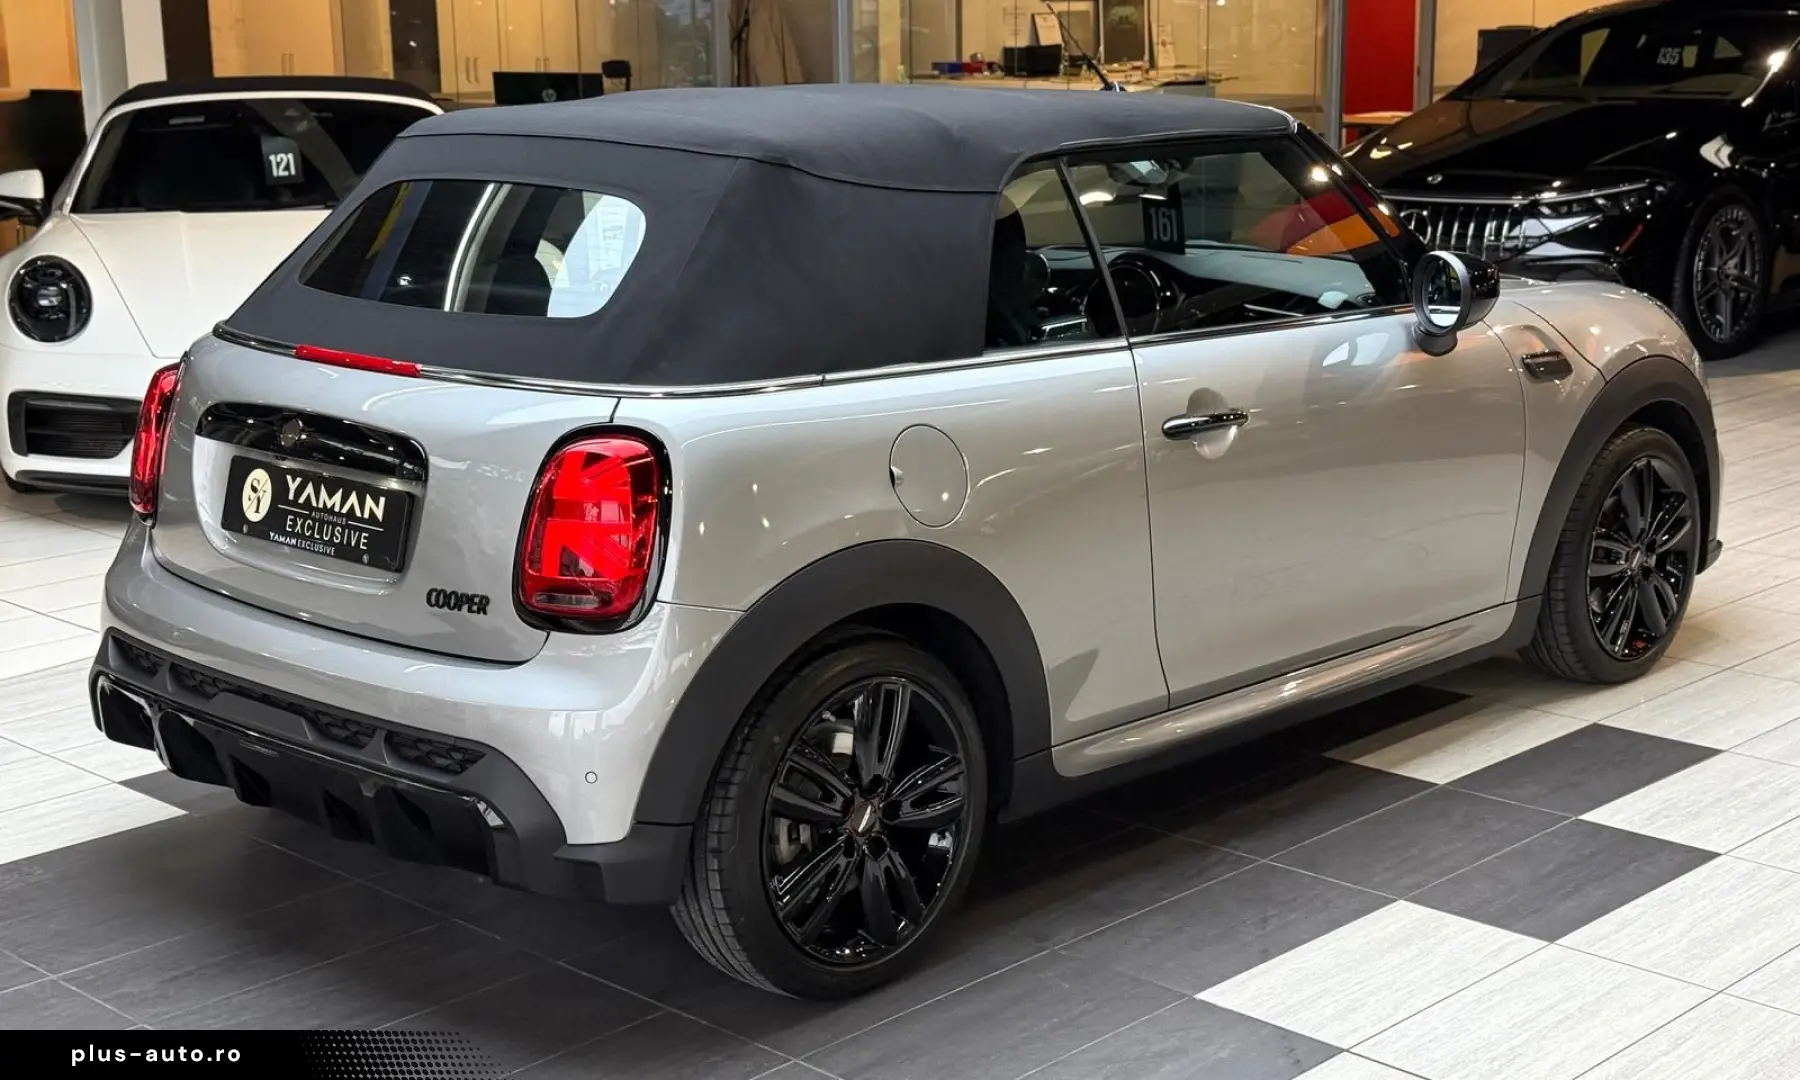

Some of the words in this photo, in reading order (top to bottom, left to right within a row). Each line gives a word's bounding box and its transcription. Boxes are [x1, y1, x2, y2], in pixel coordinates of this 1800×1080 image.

[269, 152, 296, 177] 121
[1149, 206, 1178, 242] 161
[286, 474, 386, 522] YAMAN
[286, 515, 369, 550] EXCLUSIVE
[311, 511, 347, 525] AUTOHAUS
[269, 531, 297, 547] YAMAN
[297, 540, 336, 556] EXCLUSIVE
[426, 587, 490, 616] COOPER
